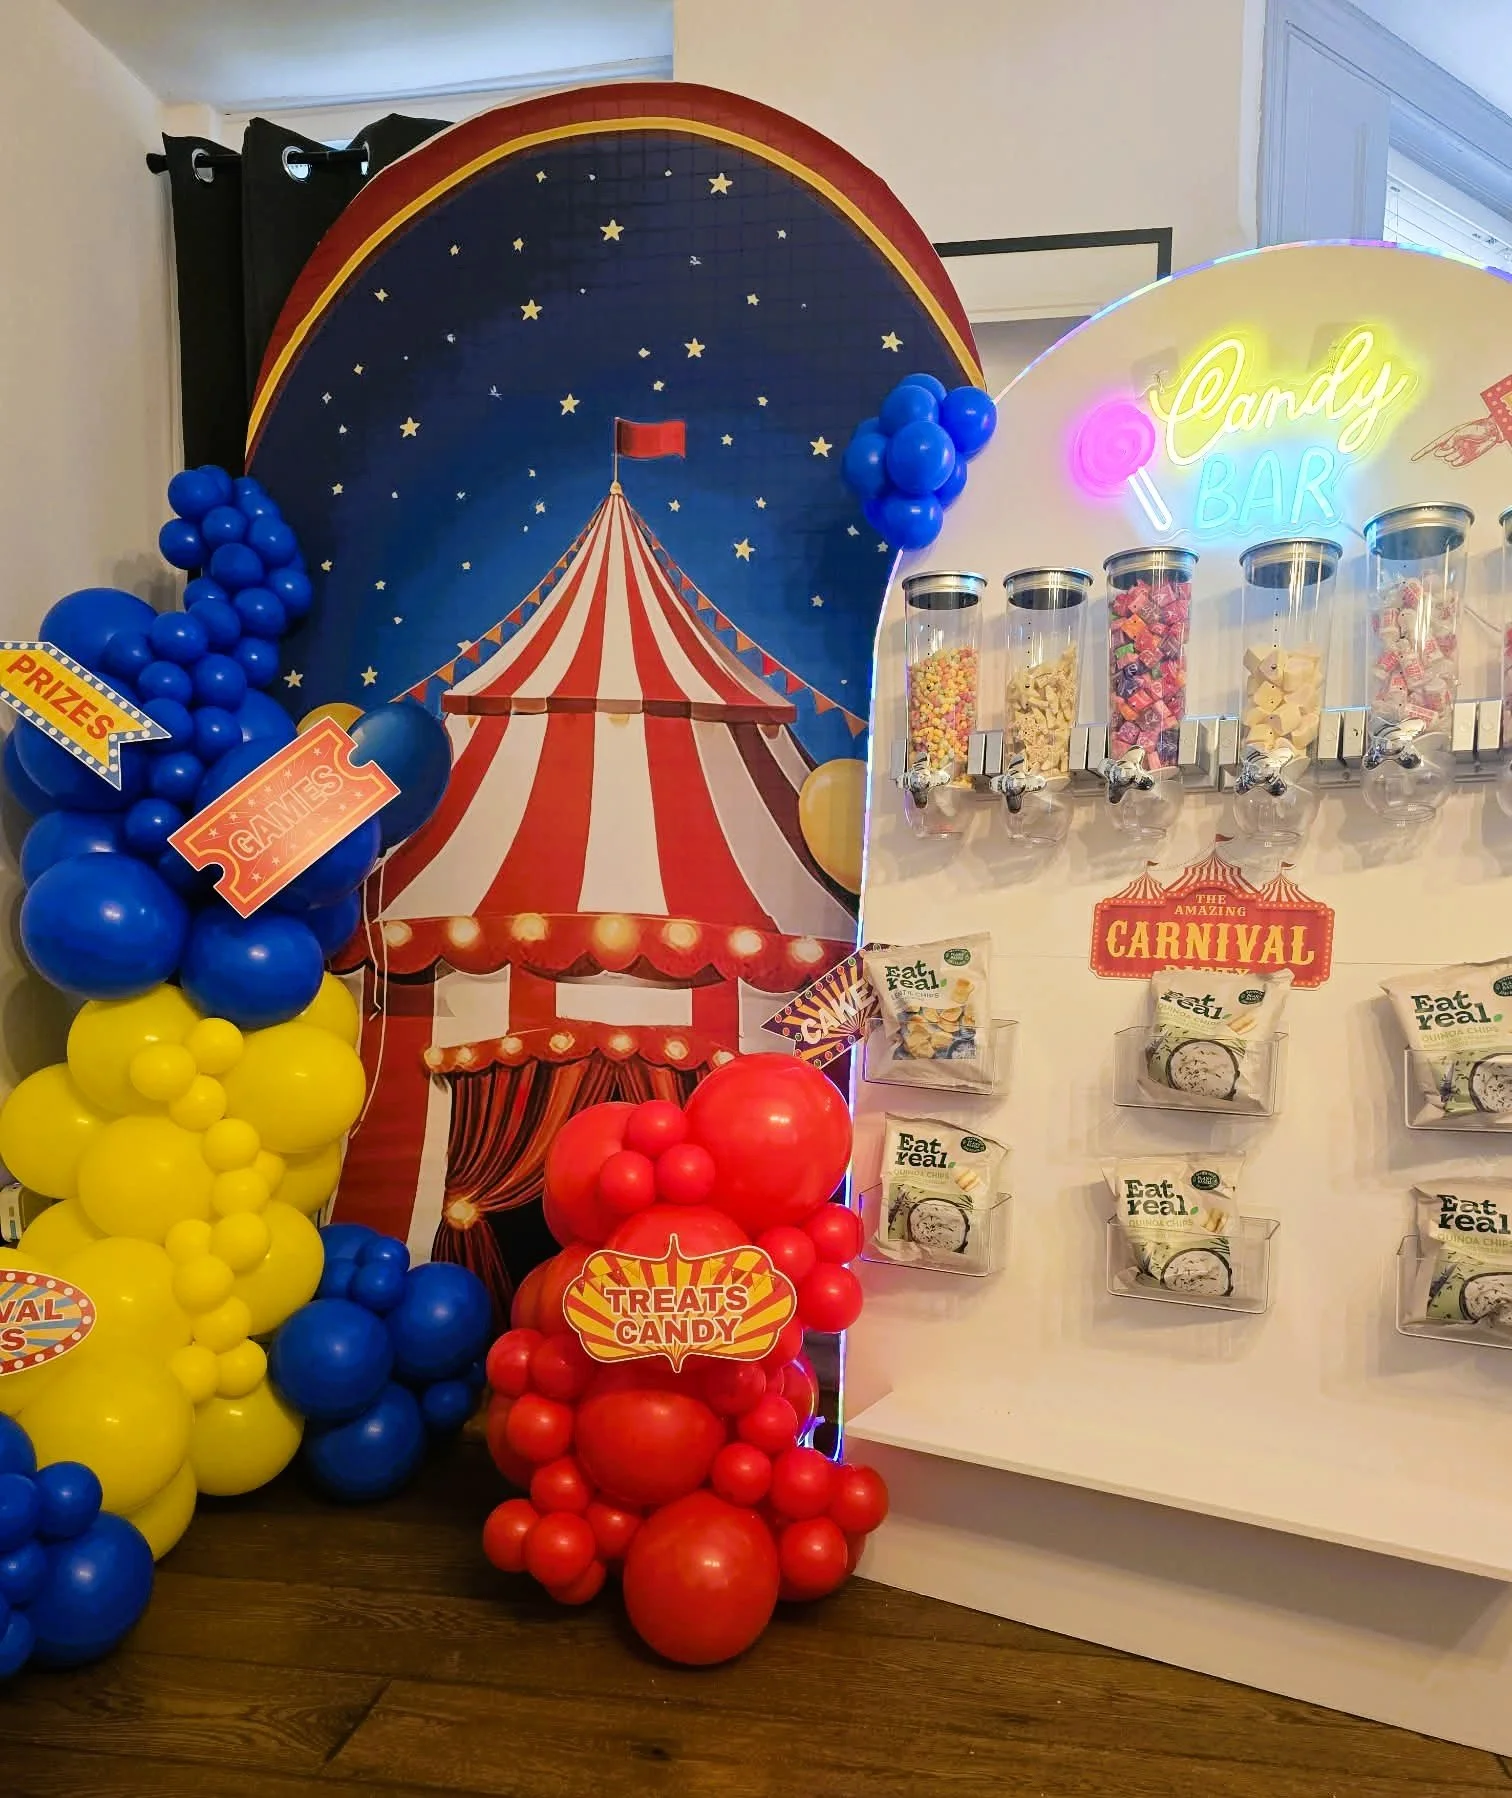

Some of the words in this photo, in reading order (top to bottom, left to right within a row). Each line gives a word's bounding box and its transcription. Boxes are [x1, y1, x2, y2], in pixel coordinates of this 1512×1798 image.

[1150, 331, 1409, 466] Candy
[1194, 446, 1335, 529] BAR
[5, 653, 116, 741] PRIZES
[227, 764, 345, 861] GAMES
[1174, 905, 1247, 917] AMAZING
[1195, 894, 1227, 905] THE
[1105, 920, 1315, 965] CARNIVAL
[885, 960, 928, 978] Eat
[887, 970, 940, 991] real
[801, 978, 876, 1045] CAKE
[1411, 990, 1473, 1014] Eat
[1416, 1003, 1492, 1030] real
[898, 1132, 942, 1154] Eat
[895, 1150, 948, 1168] real
[1124, 1179, 1175, 1199] Eat
[1127, 1194, 1188, 1216] real
[1437, 1194, 1498, 1215] Eat
[1438, 1213, 1511, 1234] real
[605, 1285, 749, 1313] TREATS
[615, 1317, 742, 1345] CANDY
